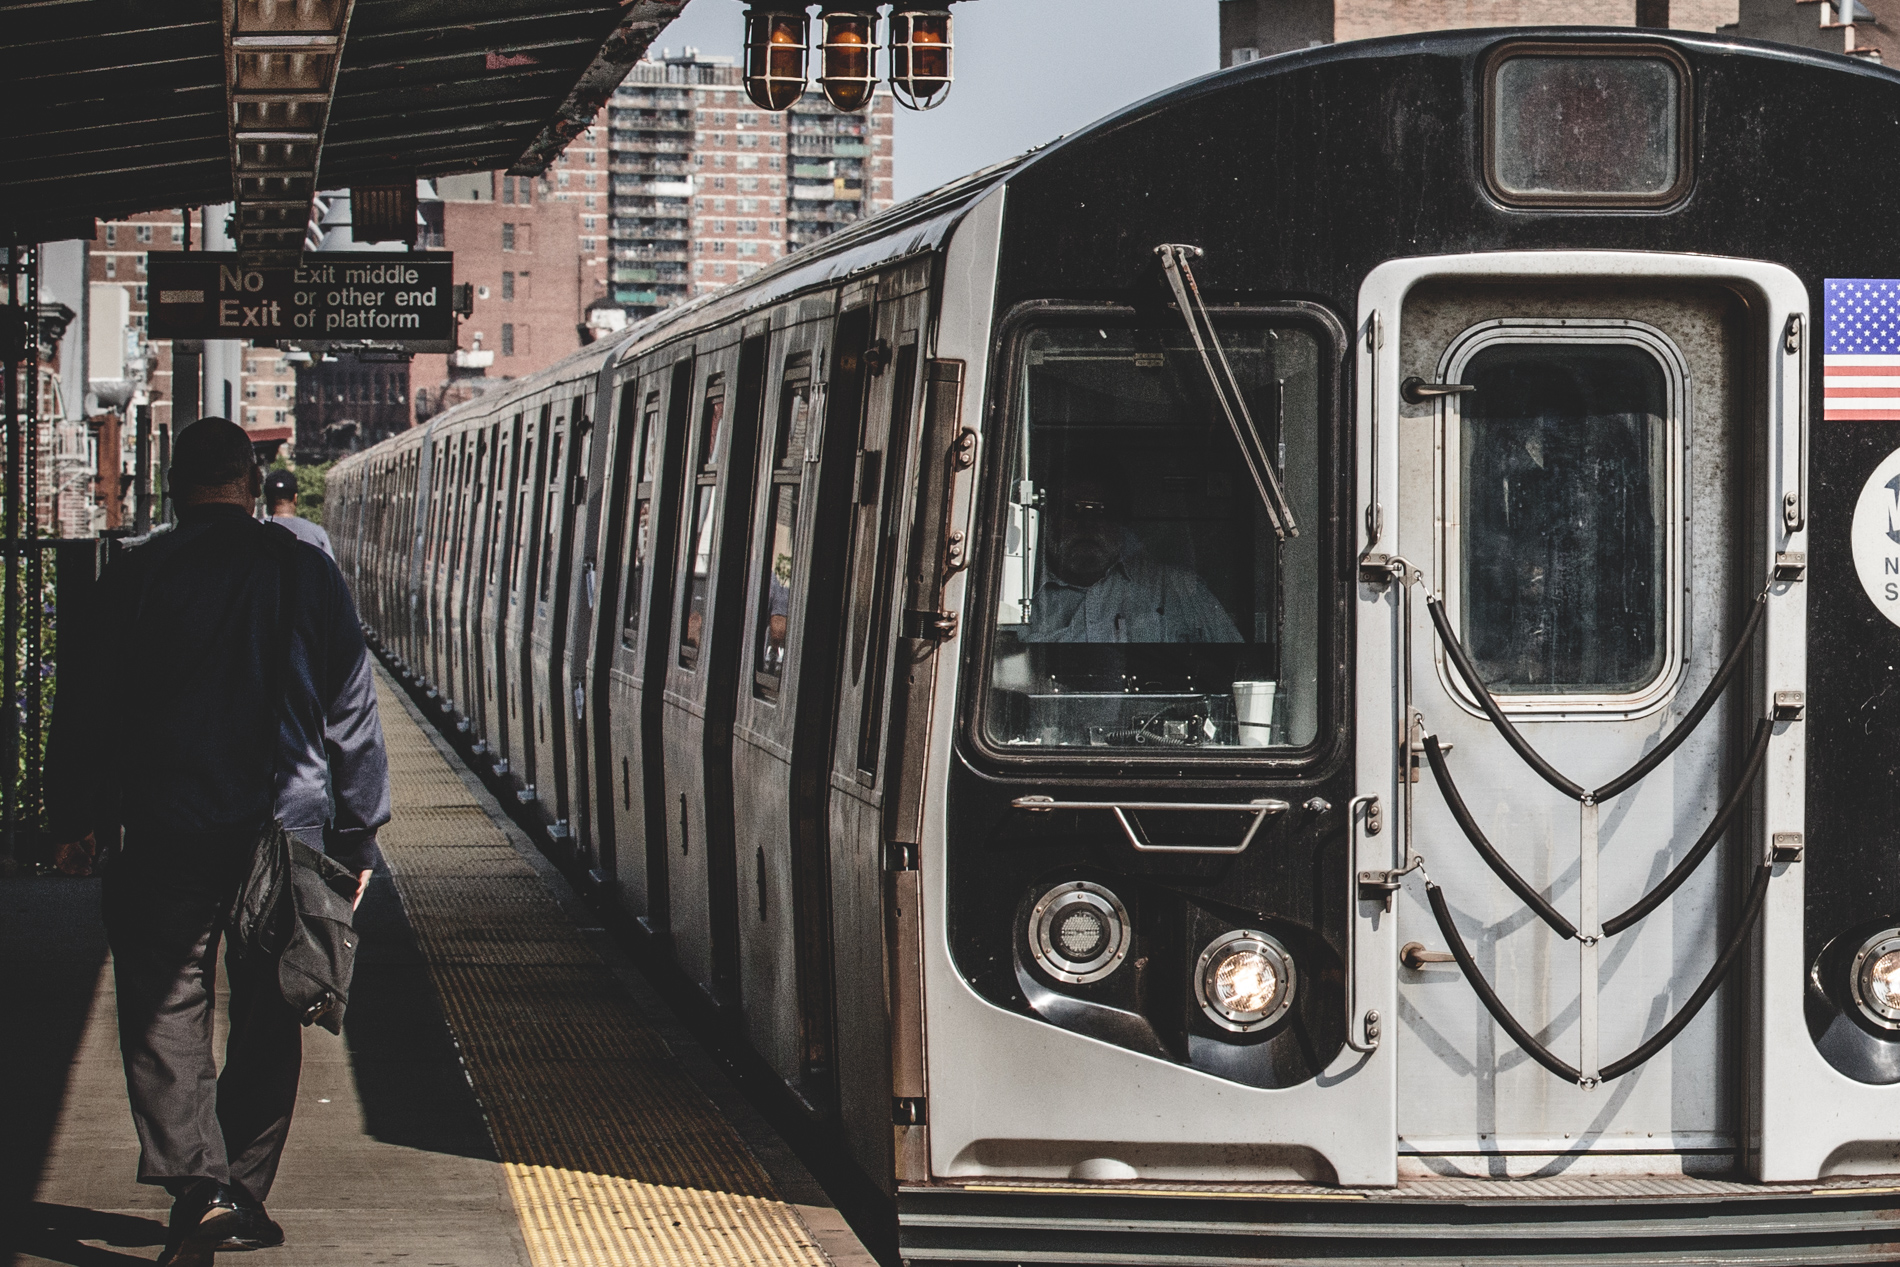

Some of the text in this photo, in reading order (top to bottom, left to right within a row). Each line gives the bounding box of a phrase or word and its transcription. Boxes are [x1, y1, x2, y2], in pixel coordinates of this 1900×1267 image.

[220, 264, 264, 292] No
[294, 265, 419, 284] Exit middle
[294, 287, 437, 306] or other end
[220, 299, 281, 327] Exit
[294, 309, 420, 332] of platform
